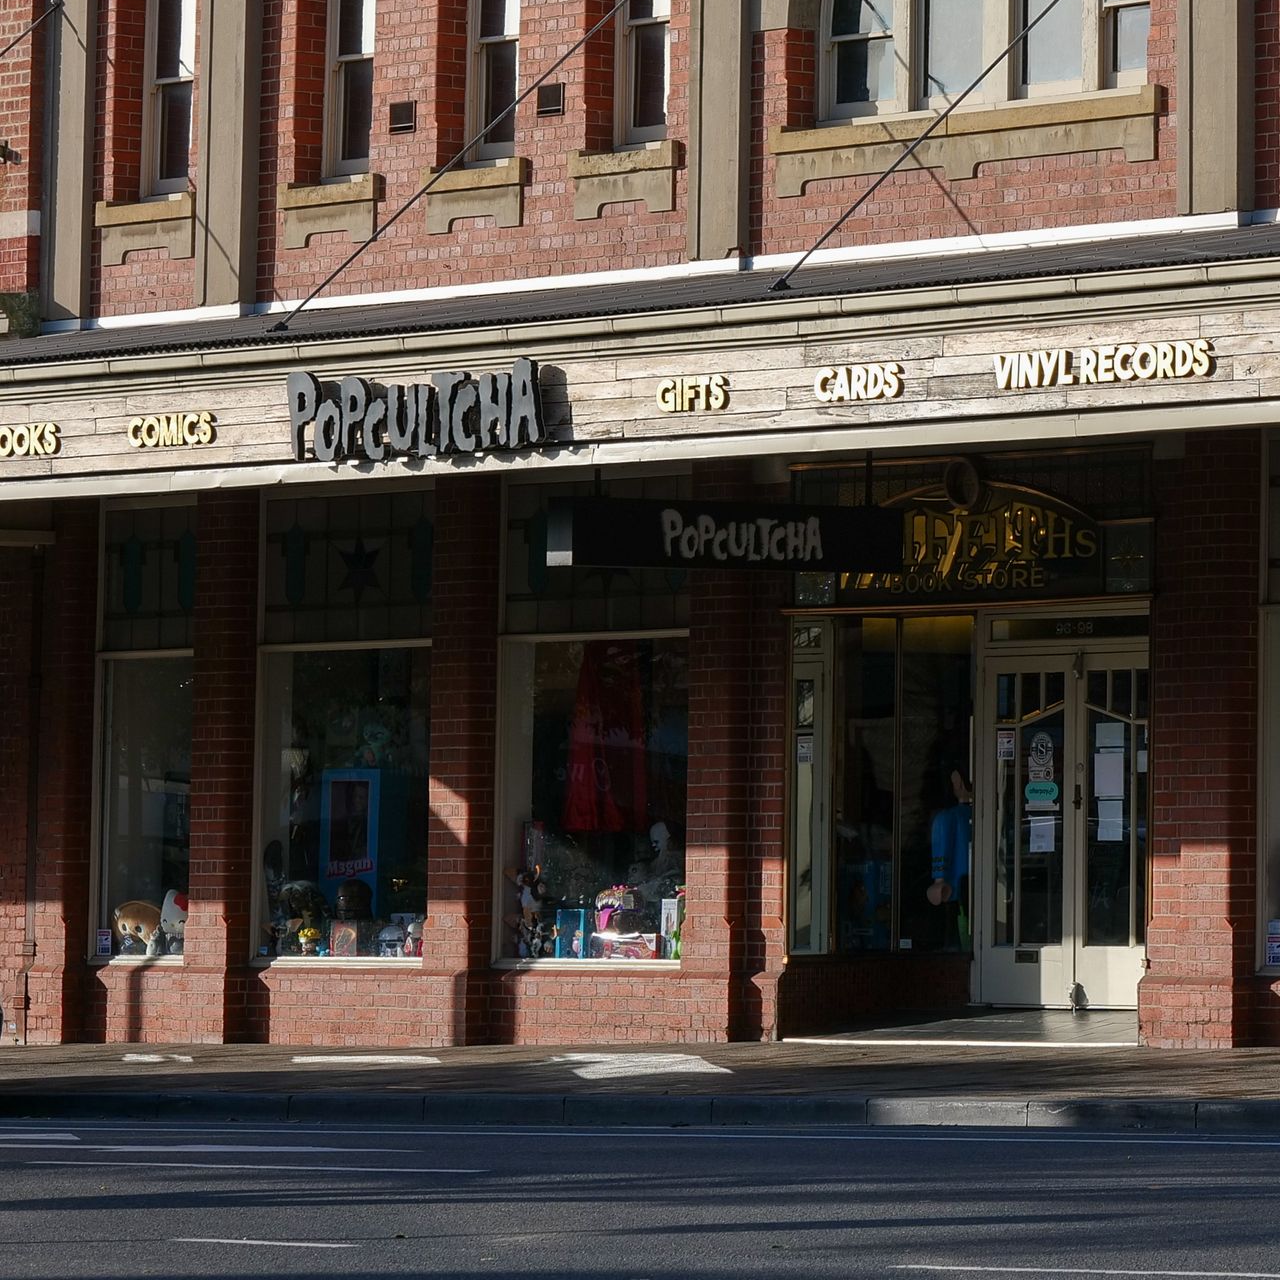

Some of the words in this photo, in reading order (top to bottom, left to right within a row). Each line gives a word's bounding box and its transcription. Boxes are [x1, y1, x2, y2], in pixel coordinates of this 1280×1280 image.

[814, 361, 904, 403] CARDS
[994, 349, 1076, 390] VINYL
[1080, 337, 1216, 385] RECORDS
[286, 357, 545, 462] POPCULTCHA
[656, 374, 730, 413] GIFTS
[128, 411, 215, 448] COMICS
[661, 508, 824, 561] POPCULTCHA
[902, 499, 1096, 566] IFFITHS
[891, 572, 952, 594] BOOK
[962, 566, 1045, 592] STORE
